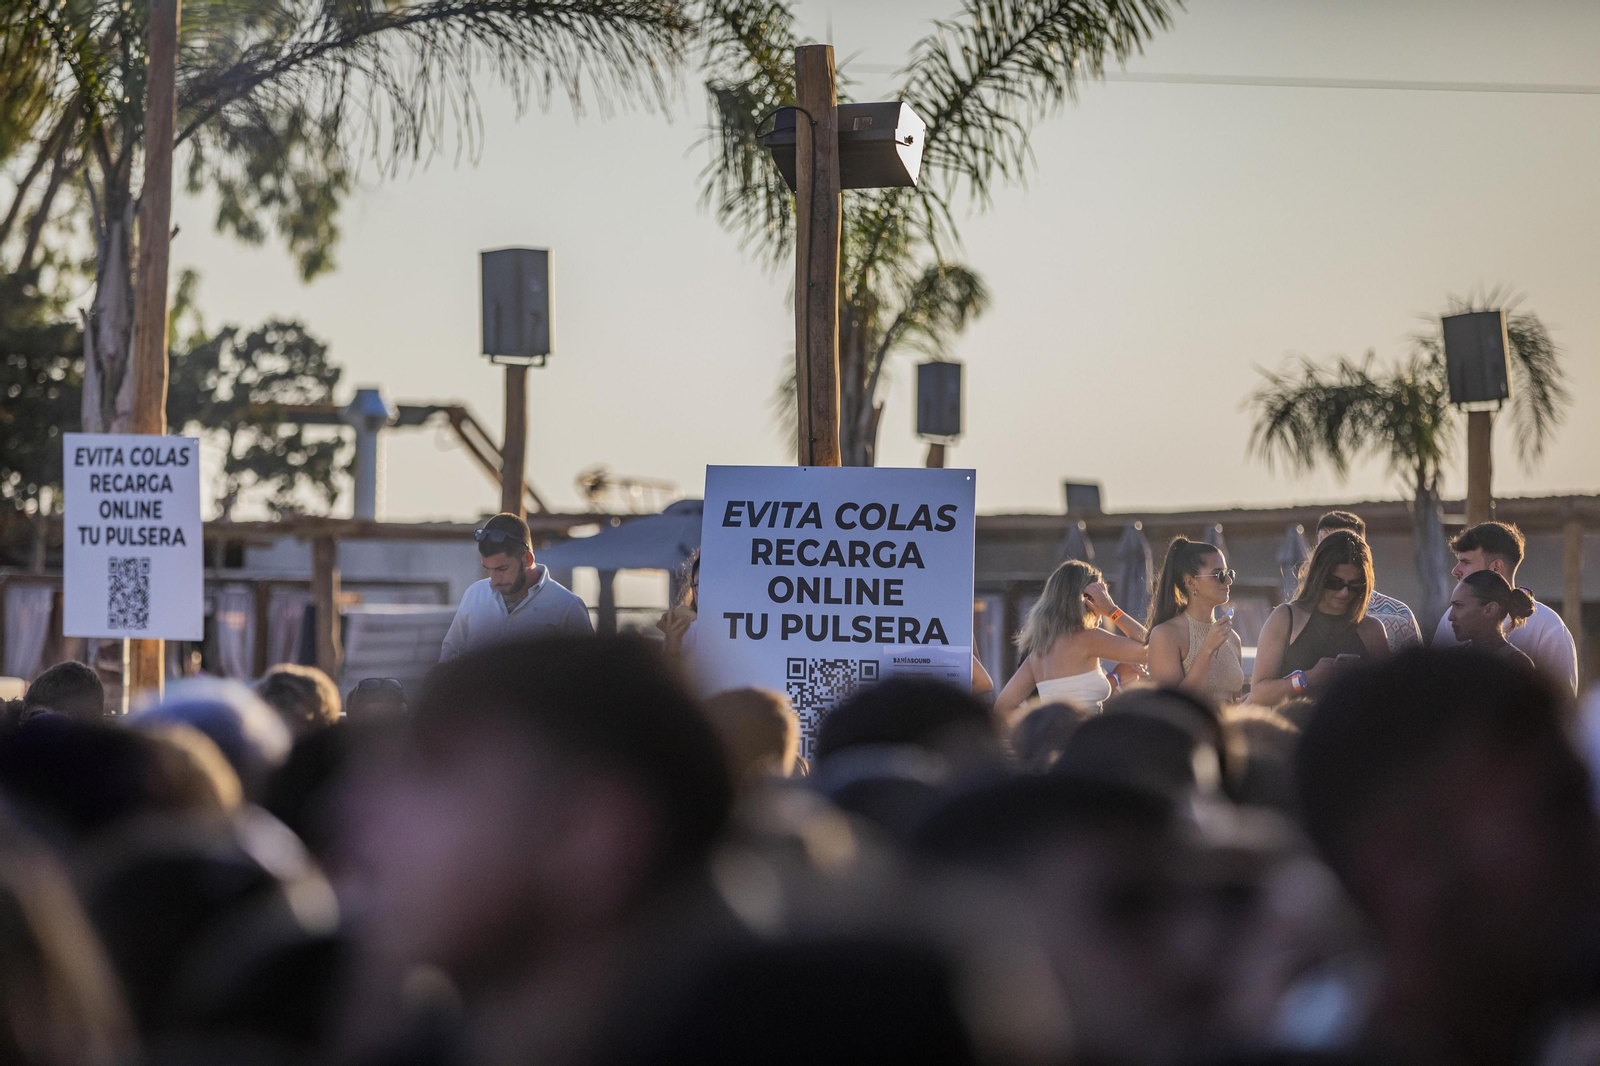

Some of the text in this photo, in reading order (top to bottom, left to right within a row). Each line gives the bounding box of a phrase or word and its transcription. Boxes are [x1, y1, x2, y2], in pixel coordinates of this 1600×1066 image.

[74, 447, 190, 467] EVITA COLAS
[90, 474, 173, 493] RECARGA
[99, 500, 162, 519] ONLINE
[722, 500, 958, 532] EVITA COLAS
[78, 526, 186, 546] TU PULSERA
[750, 538, 926, 569] RECARGA
[767, 575, 904, 606] ONLINE
[723, 612, 949, 645] TU PULSERA
